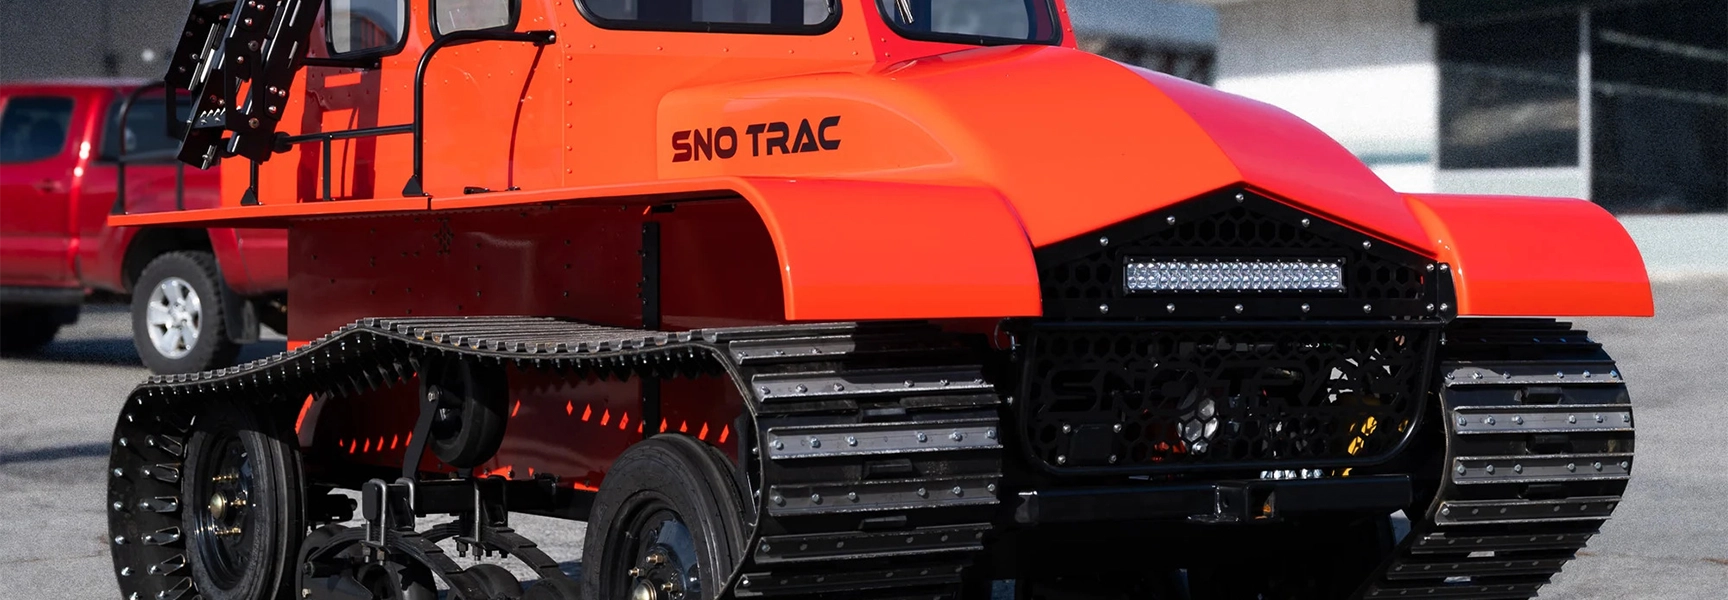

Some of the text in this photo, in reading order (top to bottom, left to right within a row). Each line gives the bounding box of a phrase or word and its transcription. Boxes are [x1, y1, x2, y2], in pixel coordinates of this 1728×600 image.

[672, 115, 841, 162] SNO TRAC
[1048, 367, 1200, 412] SNO
